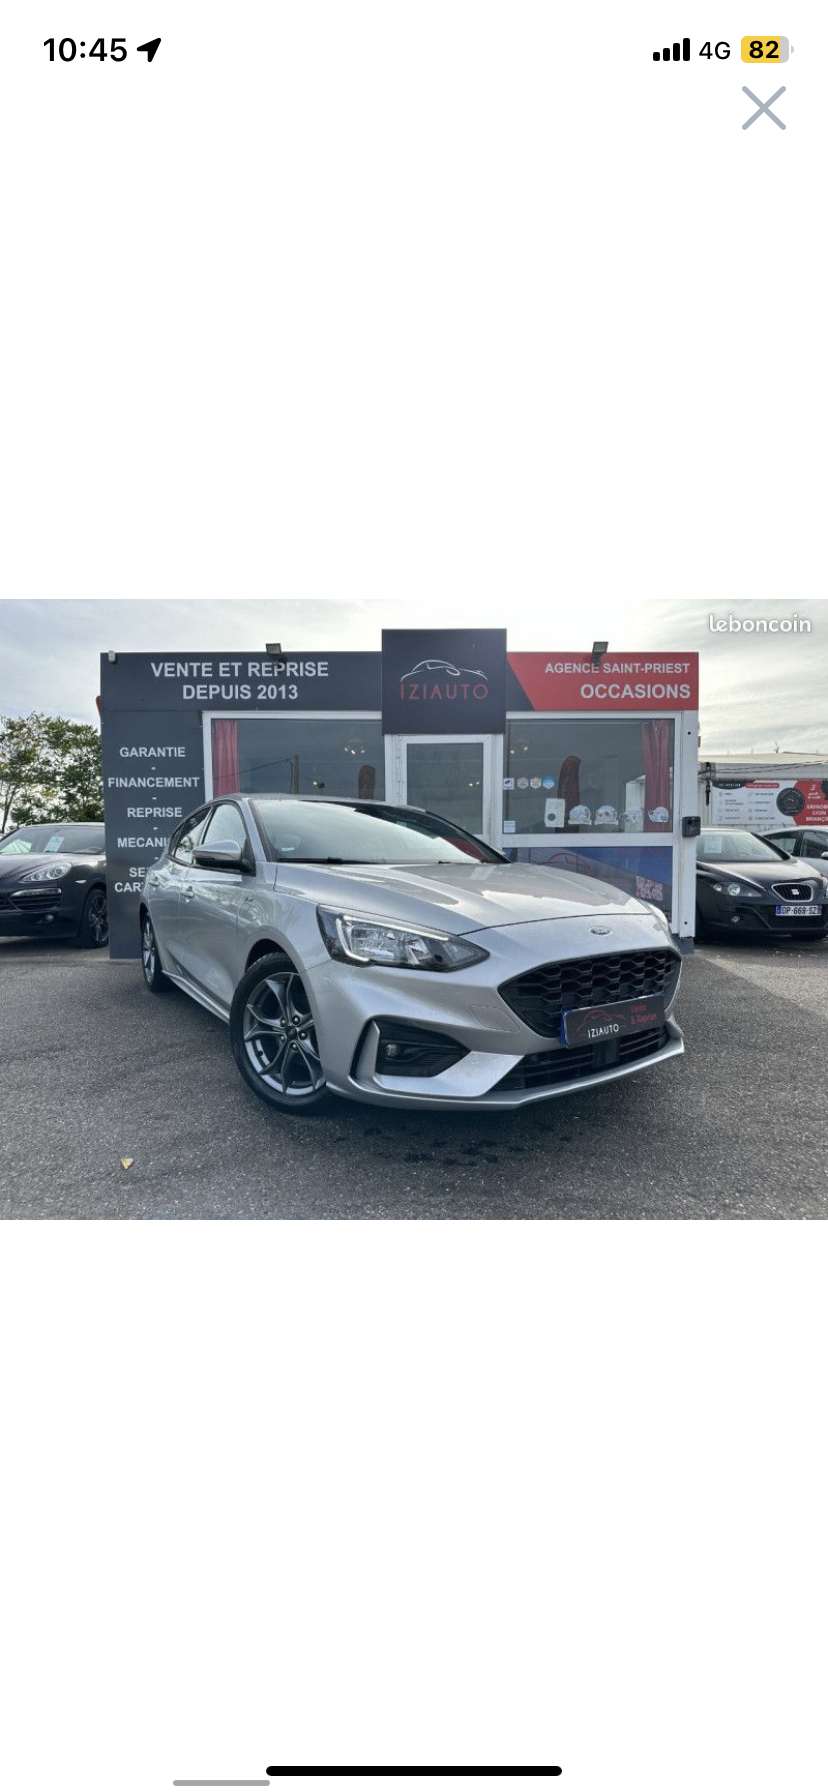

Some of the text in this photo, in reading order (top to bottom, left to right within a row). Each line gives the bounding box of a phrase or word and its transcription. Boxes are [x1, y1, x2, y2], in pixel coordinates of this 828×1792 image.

[150, 661, 329, 677] VENTE ET REPRISE
[544, 663, 690, 674] AGENCE SAINT-PRIEST
[182, 684, 299, 700] DEPUIS 2013
[400, 683, 489, 700] IZIAUTO
[580, 683, 691, 699] OCCASIONS
[119, 746, 186, 759] GARANTIE
[107, 776, 200, 788] FINANCEMENT
[127, 806, 183, 818] REPRISE
[117, 837, 168, 848] MECANI
[129, 867, 148, 878] SE
[114, 882, 143, 893] CAR
[587, 1023, 620, 1038] IZIAUTO
